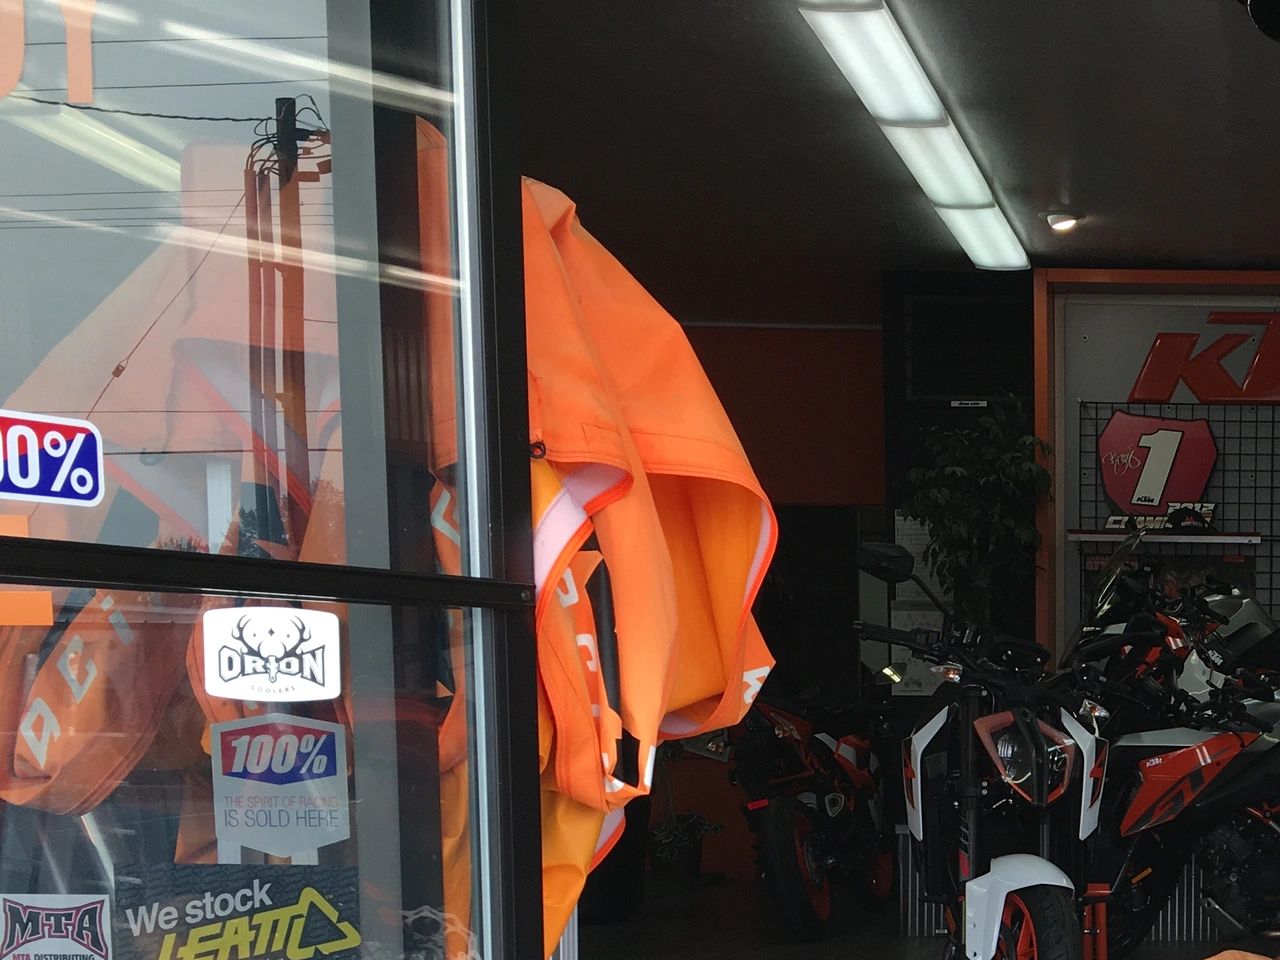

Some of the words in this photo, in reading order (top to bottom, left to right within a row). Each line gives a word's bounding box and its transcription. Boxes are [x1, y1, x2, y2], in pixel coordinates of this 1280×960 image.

[0, 425, 94, 495] 0%
[1130, 429, 1184, 506] 1
[218, 645, 326, 687] ORION
[251, 685, 296, 694] COOLERS
[231, 734, 328, 774] 100%
[224, 796, 243, 807] THE
[246, 796, 279, 807] SPIRIT
[282, 796, 297, 807] OF
[300, 796, 338, 807] RACING
[224, 810, 239, 827] IS
[244, 810, 290, 827] SOLD
[296, 810, 339, 827] HERE
[1, 899, 108, 959] MTA
[126, 902, 178, 937] We
[185, 879, 272, 924] stock
